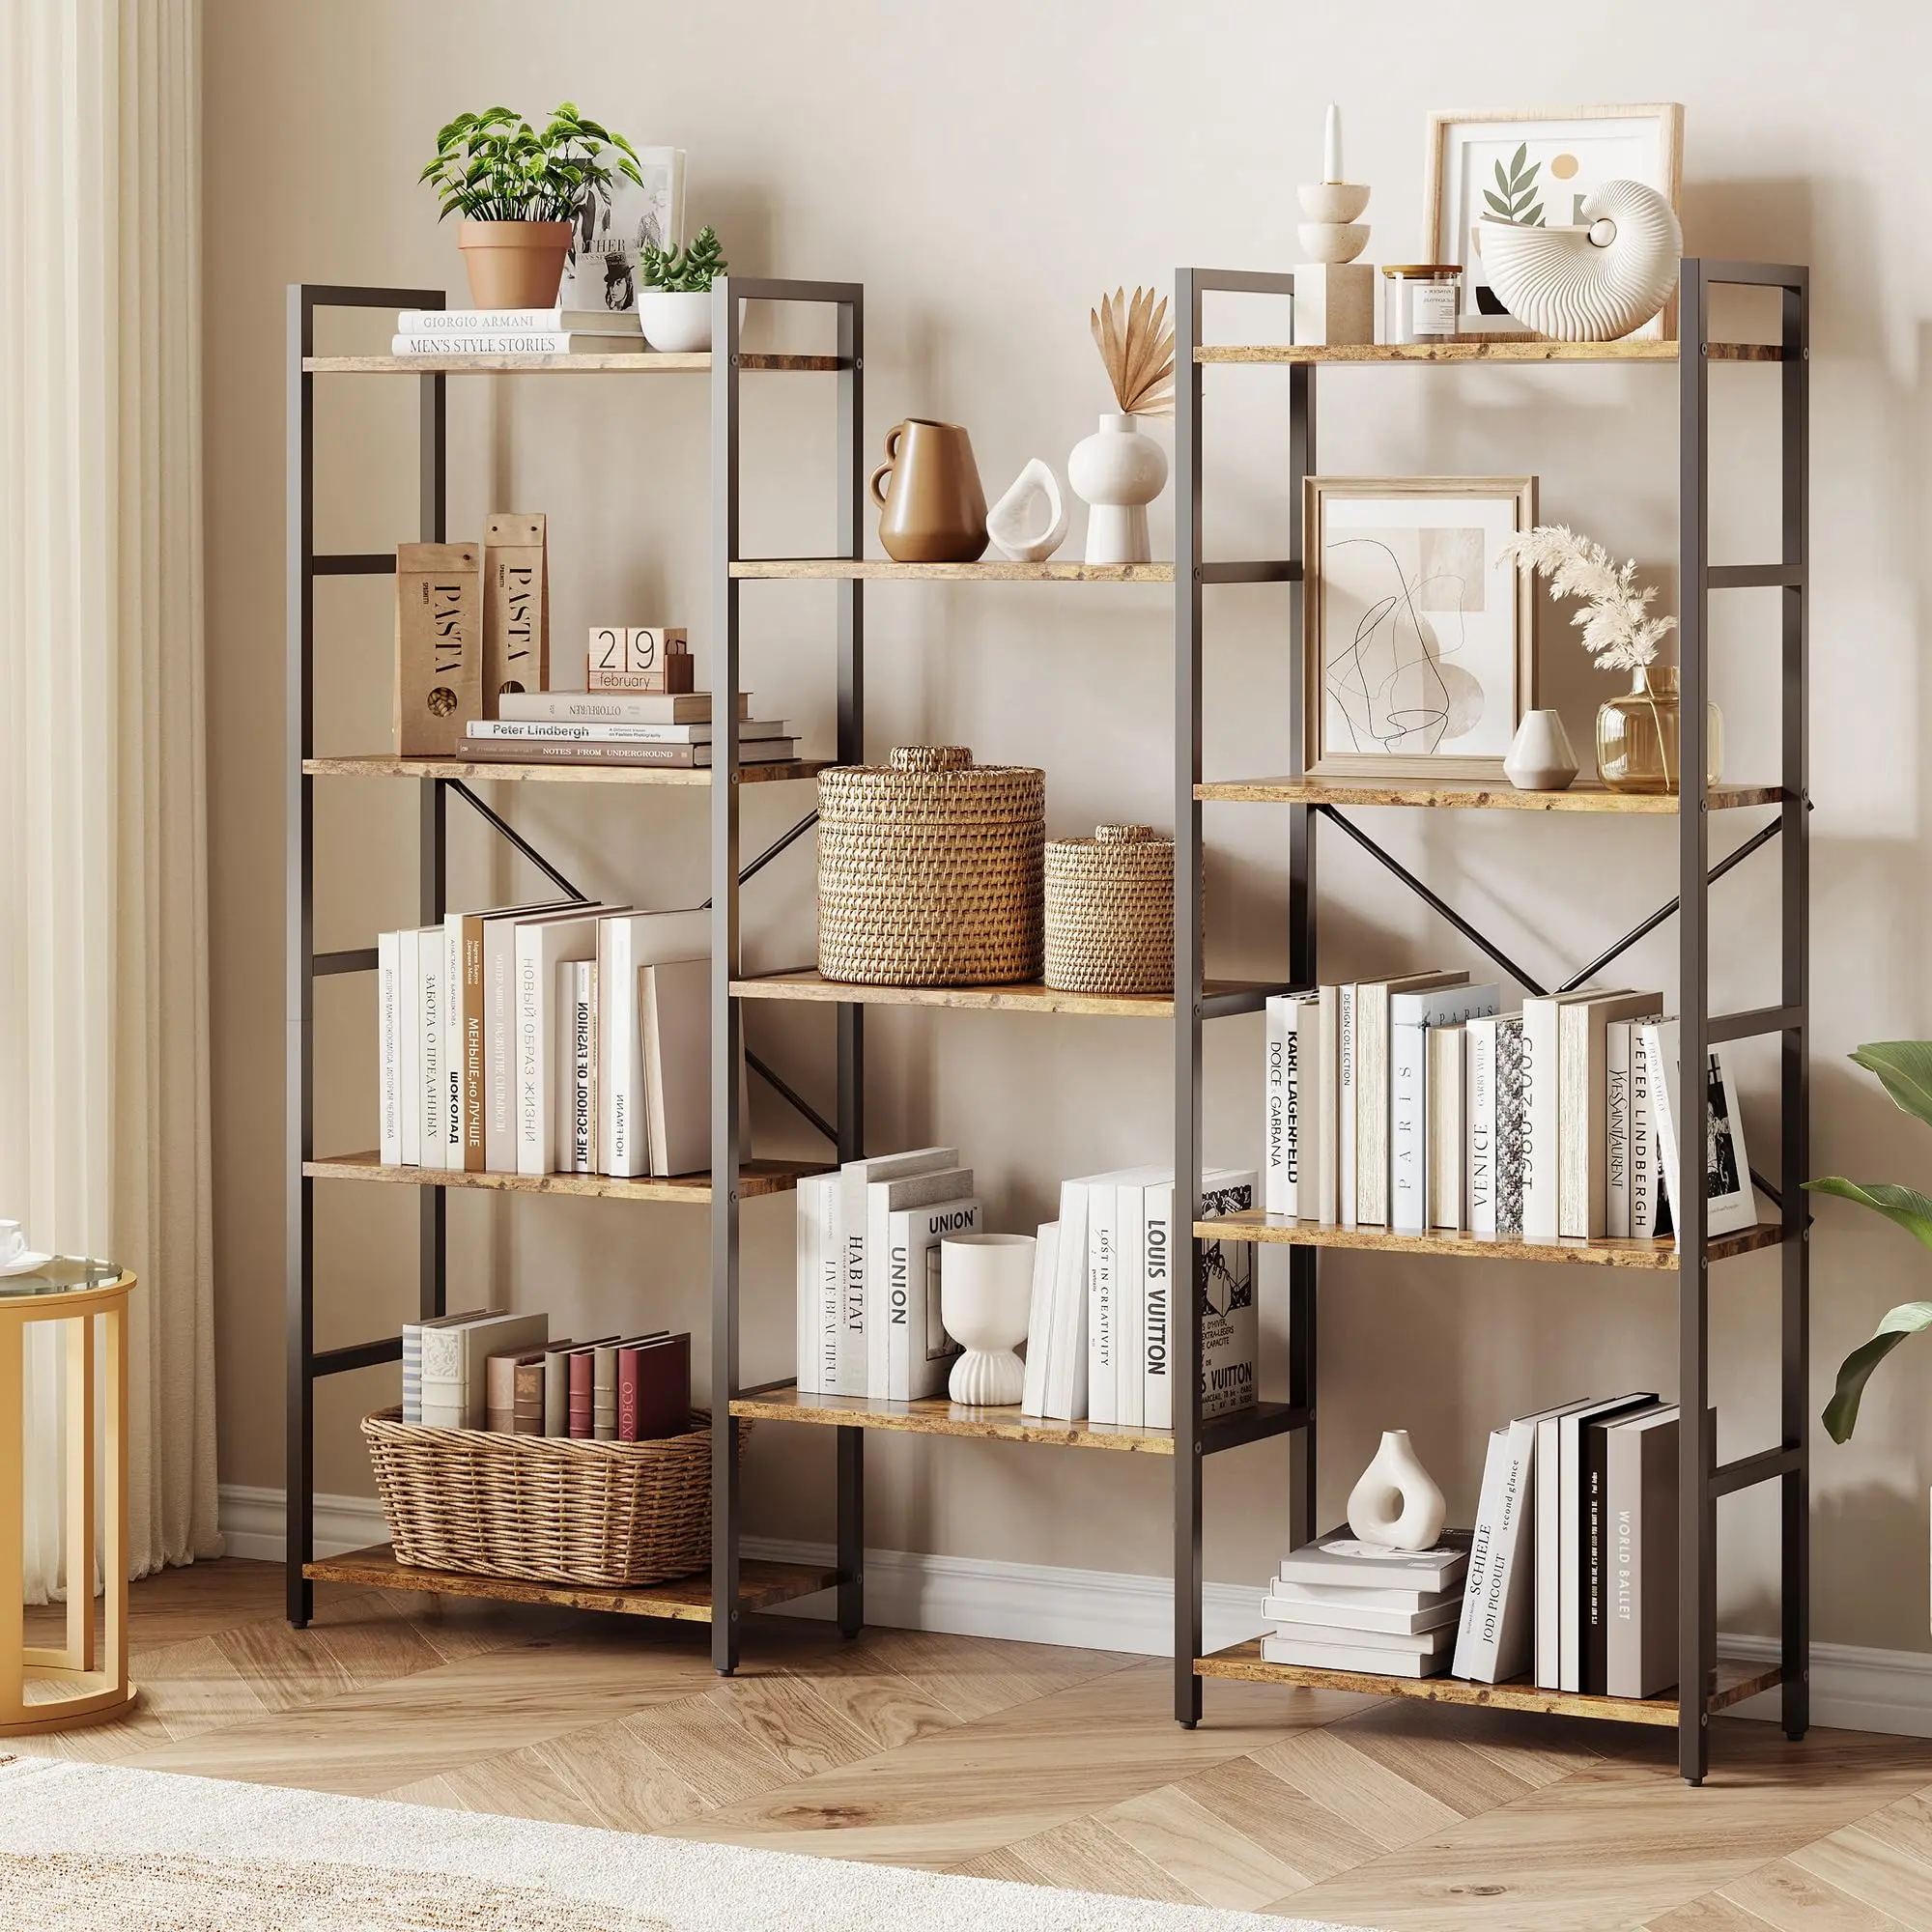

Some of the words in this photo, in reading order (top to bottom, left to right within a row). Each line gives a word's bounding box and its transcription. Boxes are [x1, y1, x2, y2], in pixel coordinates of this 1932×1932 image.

[410, 338, 451, 354] MEN'S
[453, 338, 496, 353] STYLE
[498, 337, 556, 353] STORIES
[423, 316, 478, 328] GIORGIO
[481, 315, 534, 328] ARMANI
[434, 585, 463, 674] PASTA
[507, 568, 532, 662] PASTA
[599, 671, 651, 692] february
[493, 724, 525, 736] Peter
[526, 724, 590, 739] Lindbergh
[543, 747, 572, 756] NOTES
[577, 749, 602, 757] FROM
[606, 749, 673, 759] UNDERGROUND
[425, 973, 437, 1027] ЗАБОТА
[523, 957, 535, 1017] НОВЫЙ
[1343, 993, 1351, 1028] DESIGN
[426, 1033, 438, 1043] О
[1438, 1005, 1493, 1027] PARIS
[524, 1024, 535, 1076] ОБРАЗ
[1270, 1041, 1282, 1088] DOLCE
[1288, 1031, 1298, 1079] KARL
[1343, 1029, 1351, 1087] COLLECTION
[1634, 1037, 1648, 1099] PETER
[426, 1047, 438, 1138] ПРЕДАННЫХ
[449, 1070, 460, 1145] ШОКОЛАД
[524, 1081, 536, 1143] ЖИЗНИ
[1477, 1074, 1486, 1107] GARRY
[469, 1098, 481, 1148] ЛУЧШЕ
[1270, 1095, 1282, 1168] GABBANA
[1288, 1080, 1298, 1184] LAGERFELD
[1399, 1065, 1412, 1189] PARIS
[1473, 1123, 1489, 1208] VENICE
[1634, 1110, 1648, 1227] LINDBERGH
[929, 1208, 974, 1235] UNION
[1100, 1229, 1109, 1262] LOST
[1100, 1267, 1109, 1281] IN
[1148, 1220, 1167, 1279] LOUIS
[825, 1261, 837, 1298] LIVE
[849, 1236, 864, 1334] HABITAT
[892, 1246, 906, 1324] UNION
[825, 1299, 837, 1387] BEAUTIFUL
[1100, 1287, 1109, 1367] CREATIVITY
[1148, 1290, 1166, 1376] VUITTON
[1210, 1360, 1252, 1391] VUITTON
[1507, 1460, 1520, 1493] glance
[1501, 1495, 1514, 1532] second
[1618, 1510, 1632, 1563] WORLD
[1469, 1523, 1492, 1596] SCHIELE
[1488, 1552, 1506, 1610] PICOULT
[1618, 1570, 1631, 1620] BALLET
[1482, 1610, 1496, 1644] JODI
